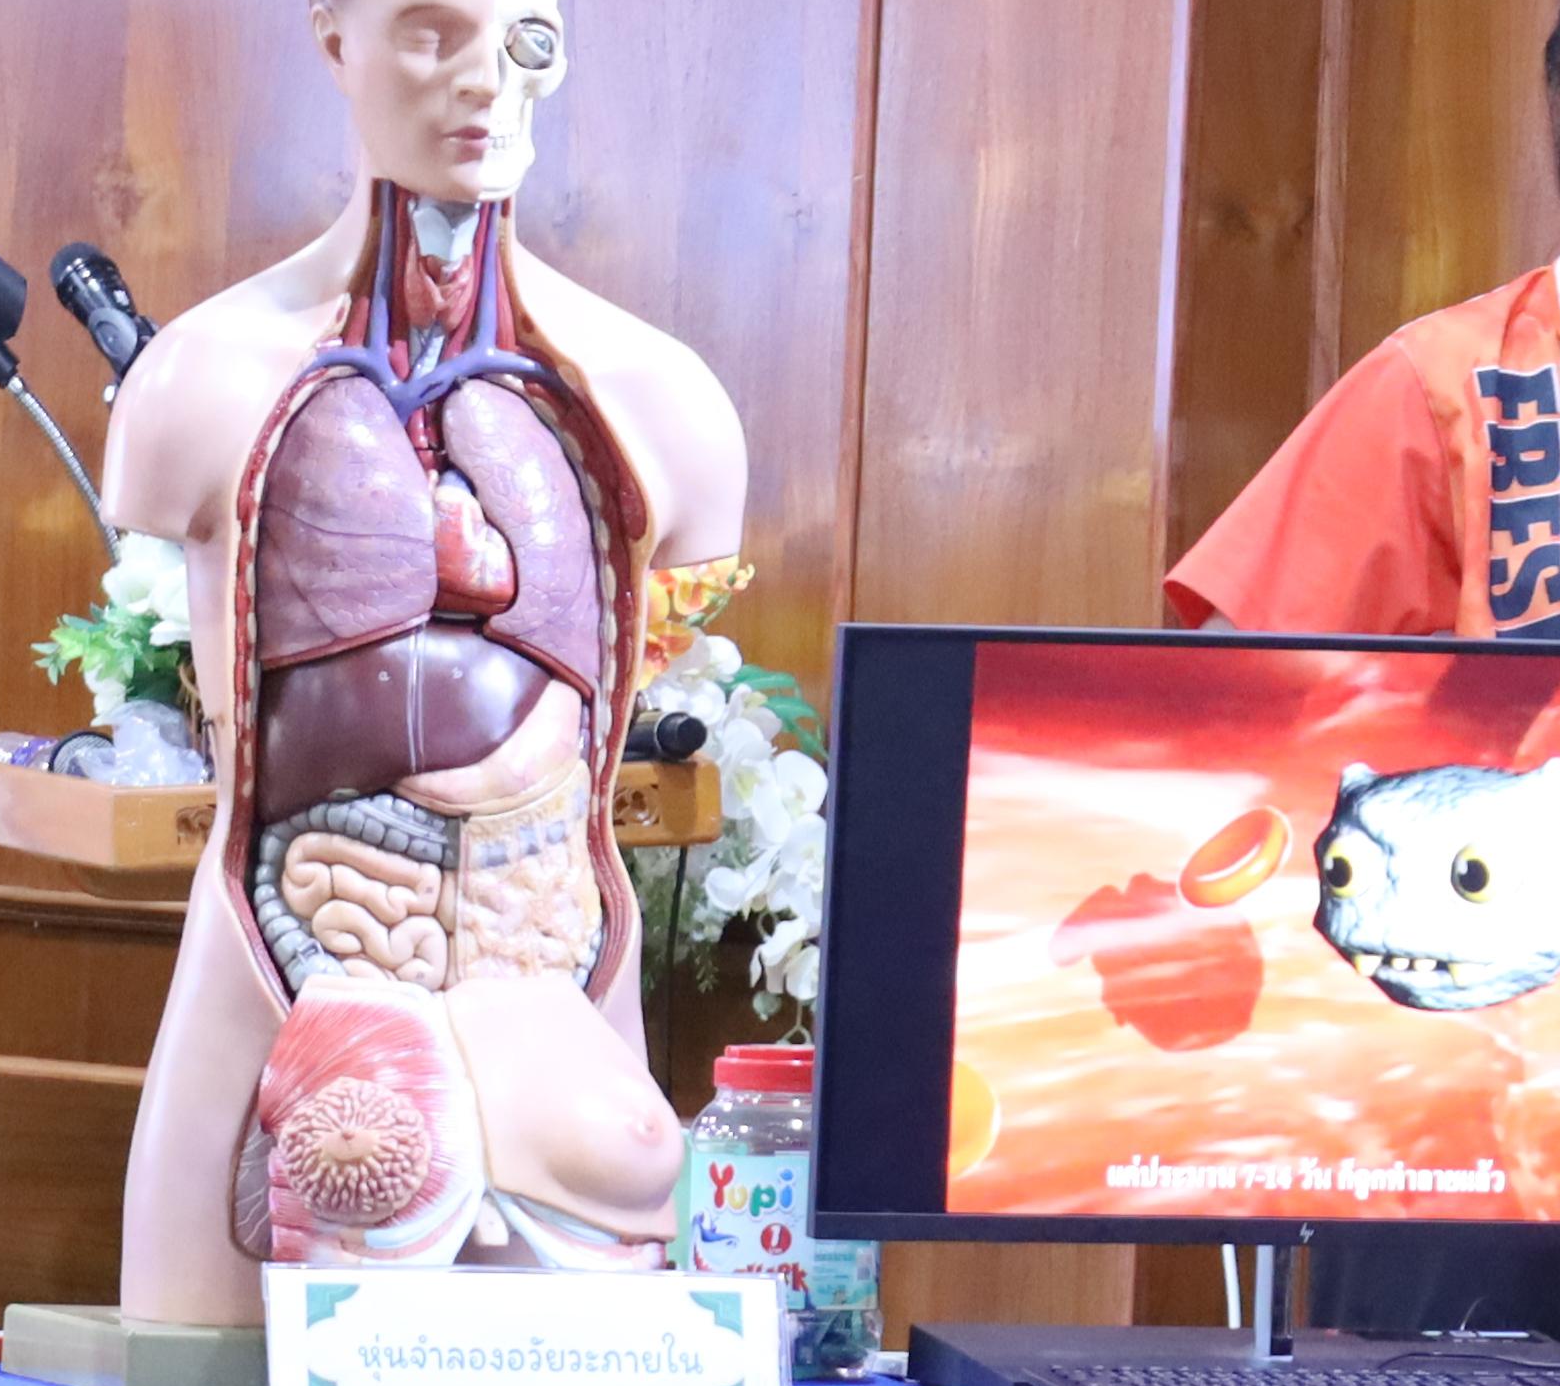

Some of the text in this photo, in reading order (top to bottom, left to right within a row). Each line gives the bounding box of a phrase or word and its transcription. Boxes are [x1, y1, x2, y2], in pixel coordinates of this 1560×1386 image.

[709, 1162, 794, 1218] Yupi
[1241, 1163, 1293, 1190] 7-14
[1300, 1156, 1332, 1191] วัน
[358, 1332, 705, 1382] หุ่นจำลองอวัยวะภายใน
